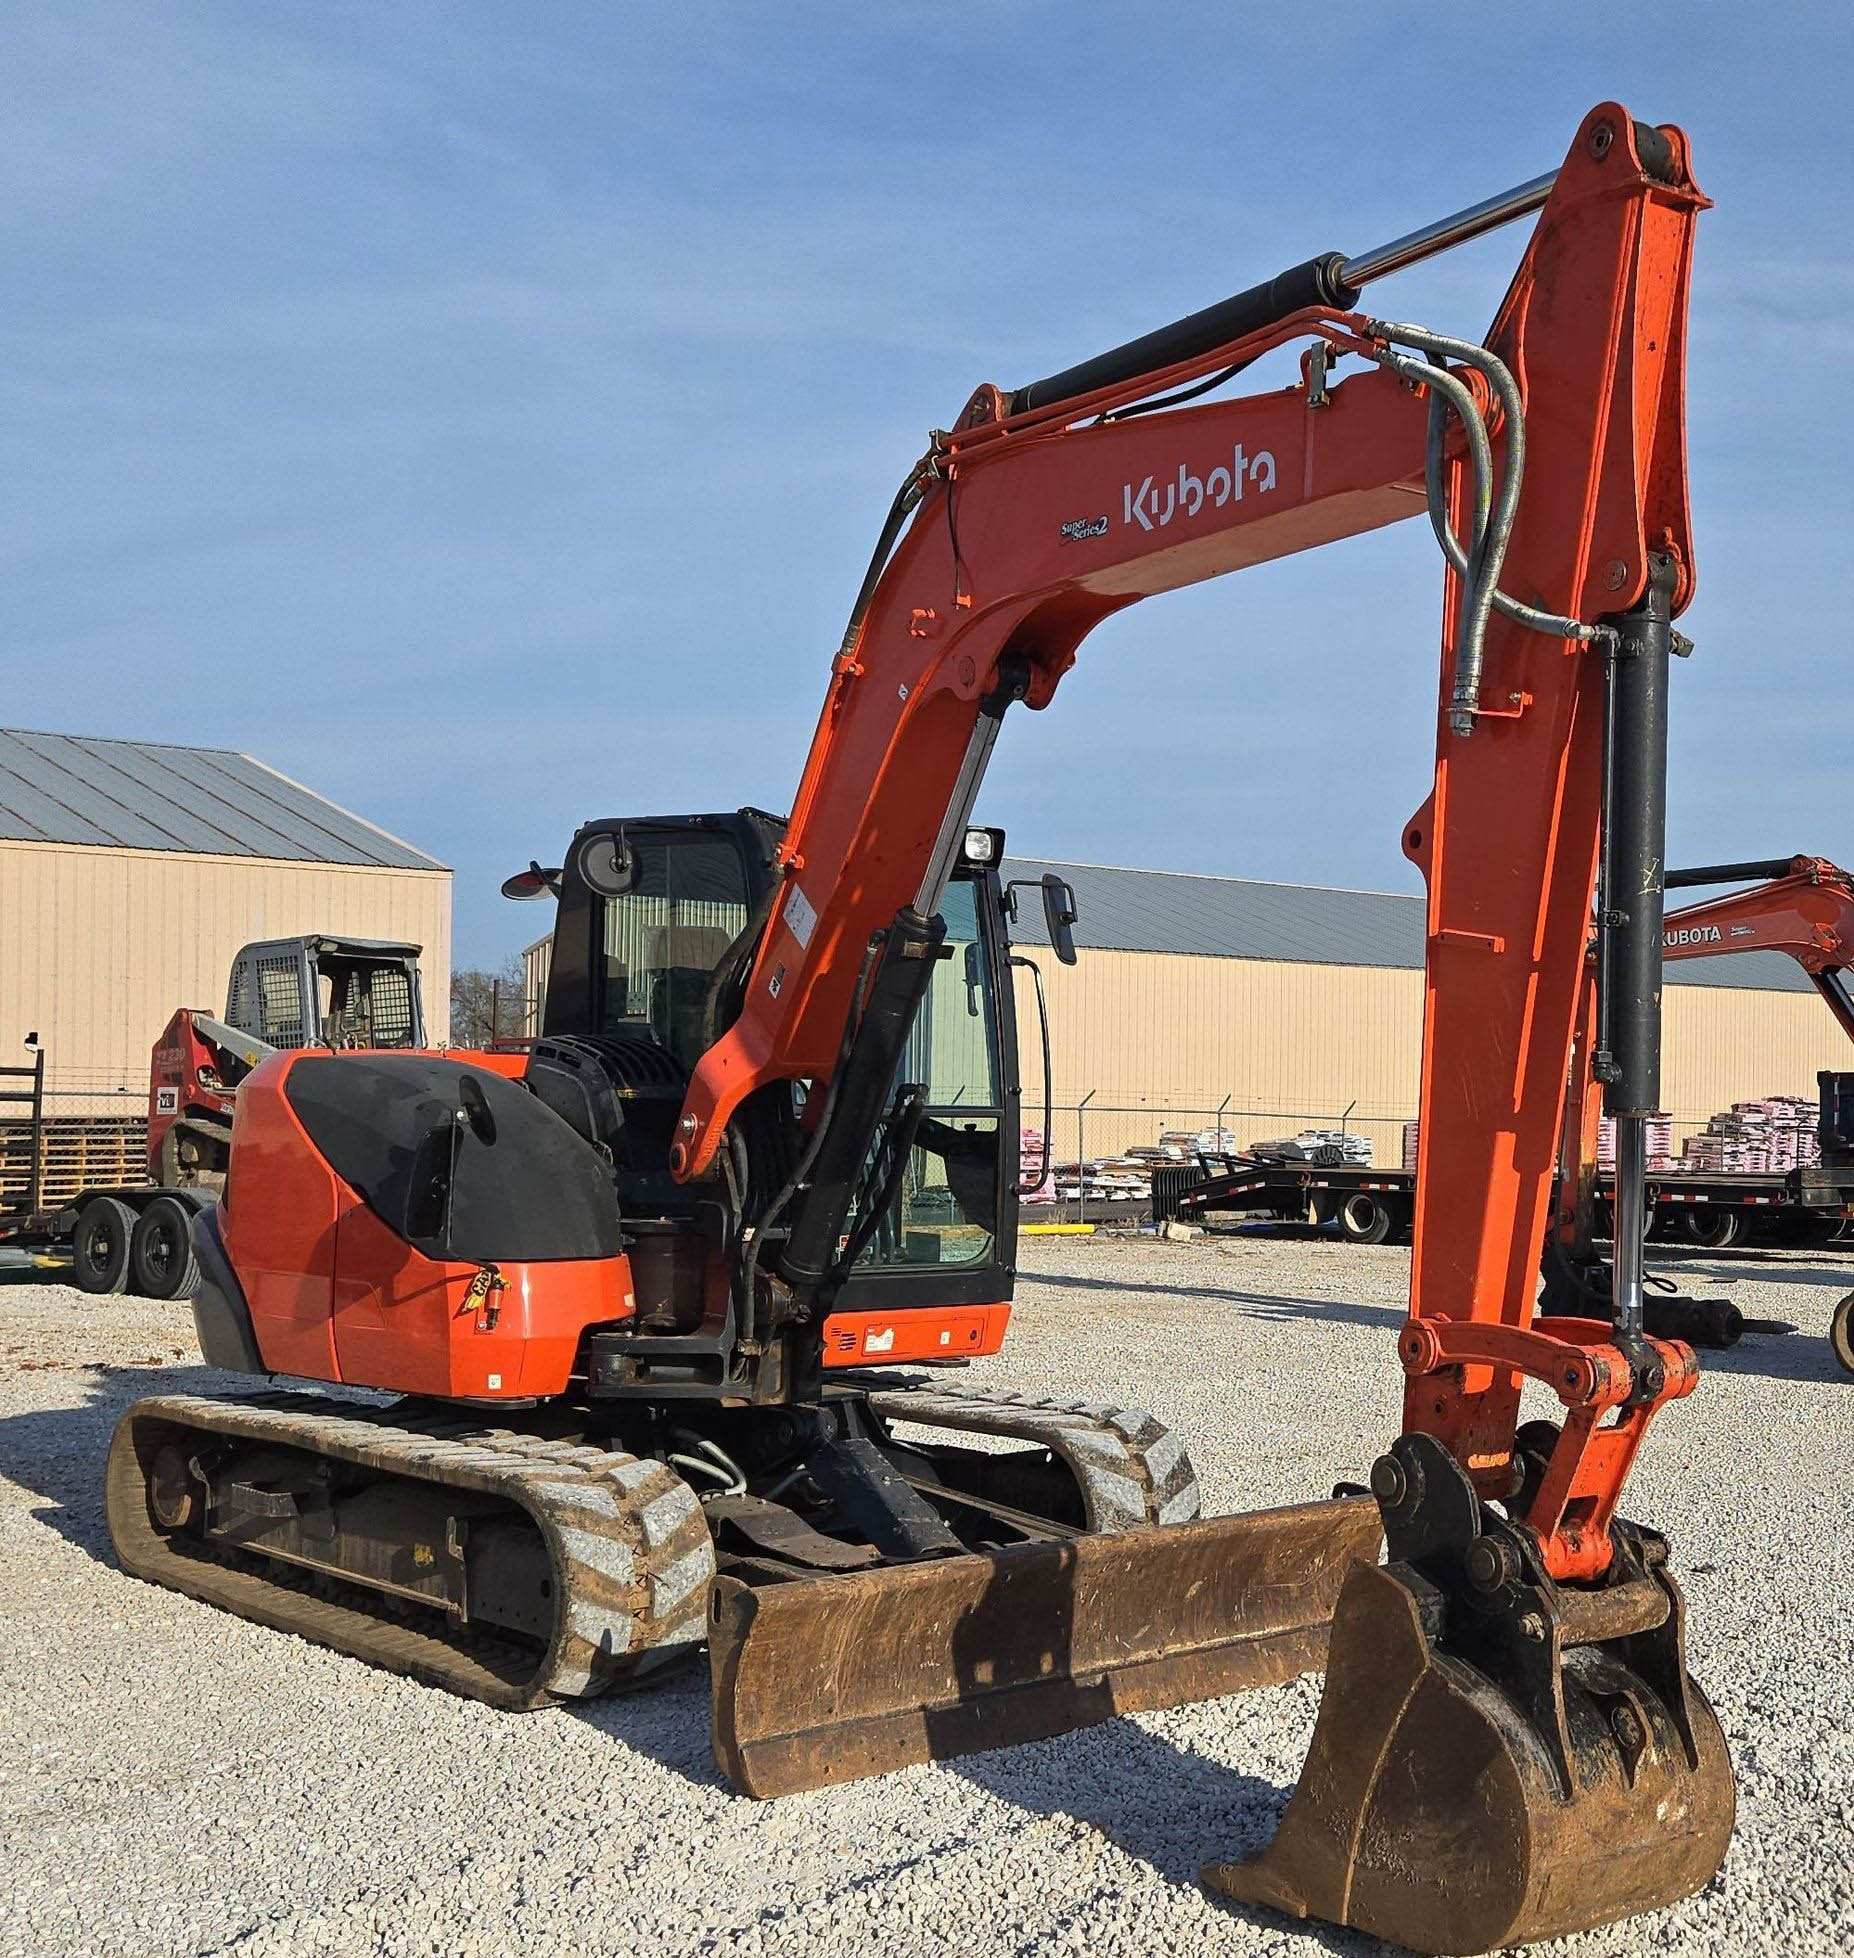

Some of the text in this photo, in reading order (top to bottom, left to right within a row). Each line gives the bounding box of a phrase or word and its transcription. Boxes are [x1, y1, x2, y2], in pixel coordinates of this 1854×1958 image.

[1123, 443, 1277, 531] Kubota
[1061, 518, 1088, 535] Super
[1662, 926, 1722, 947] KUBOTA
